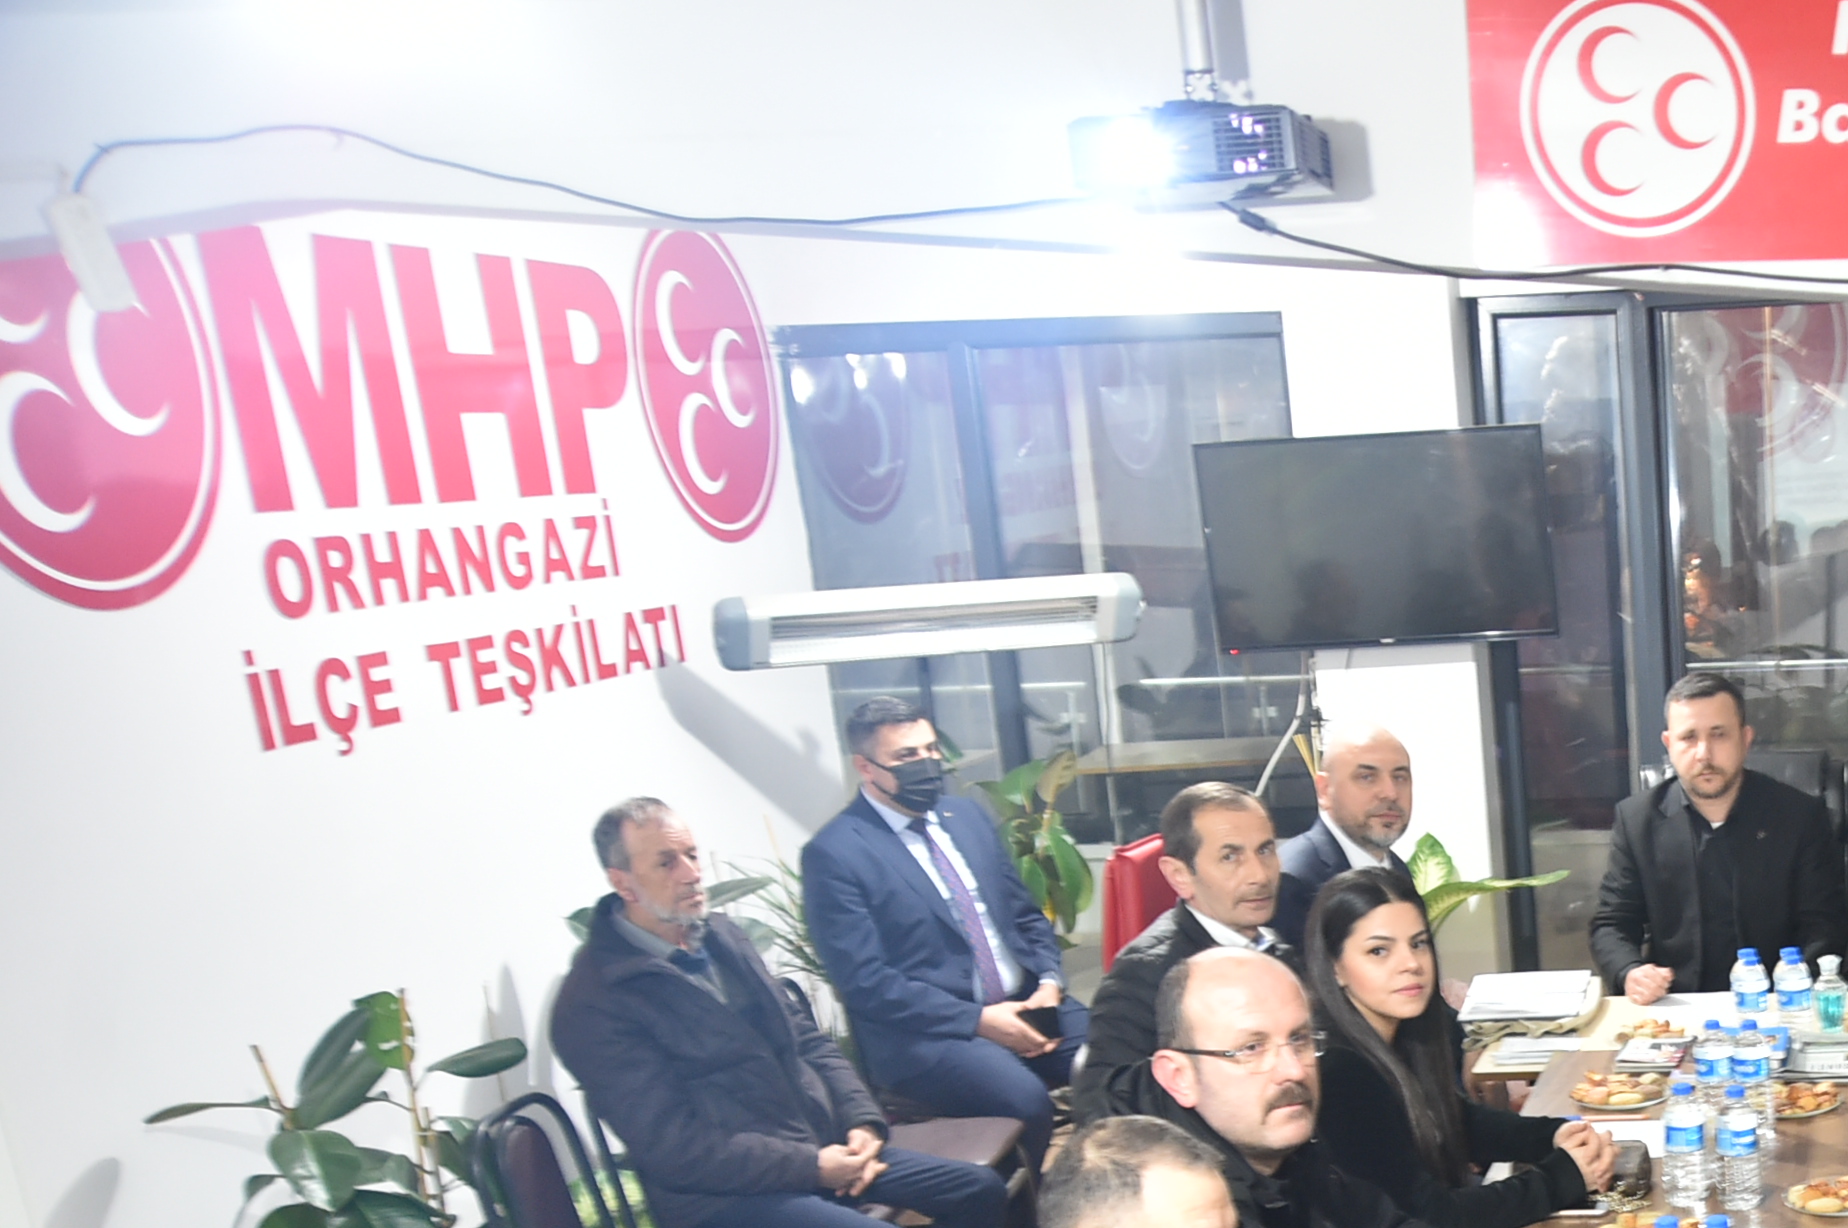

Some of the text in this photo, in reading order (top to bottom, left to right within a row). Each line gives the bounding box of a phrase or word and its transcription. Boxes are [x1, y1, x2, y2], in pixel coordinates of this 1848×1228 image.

[200, 226, 629, 512] MHP
[263, 500, 621, 619] ORHANGAZİ
[244, 604, 686, 756] İLÇE TEŞKİLATI
